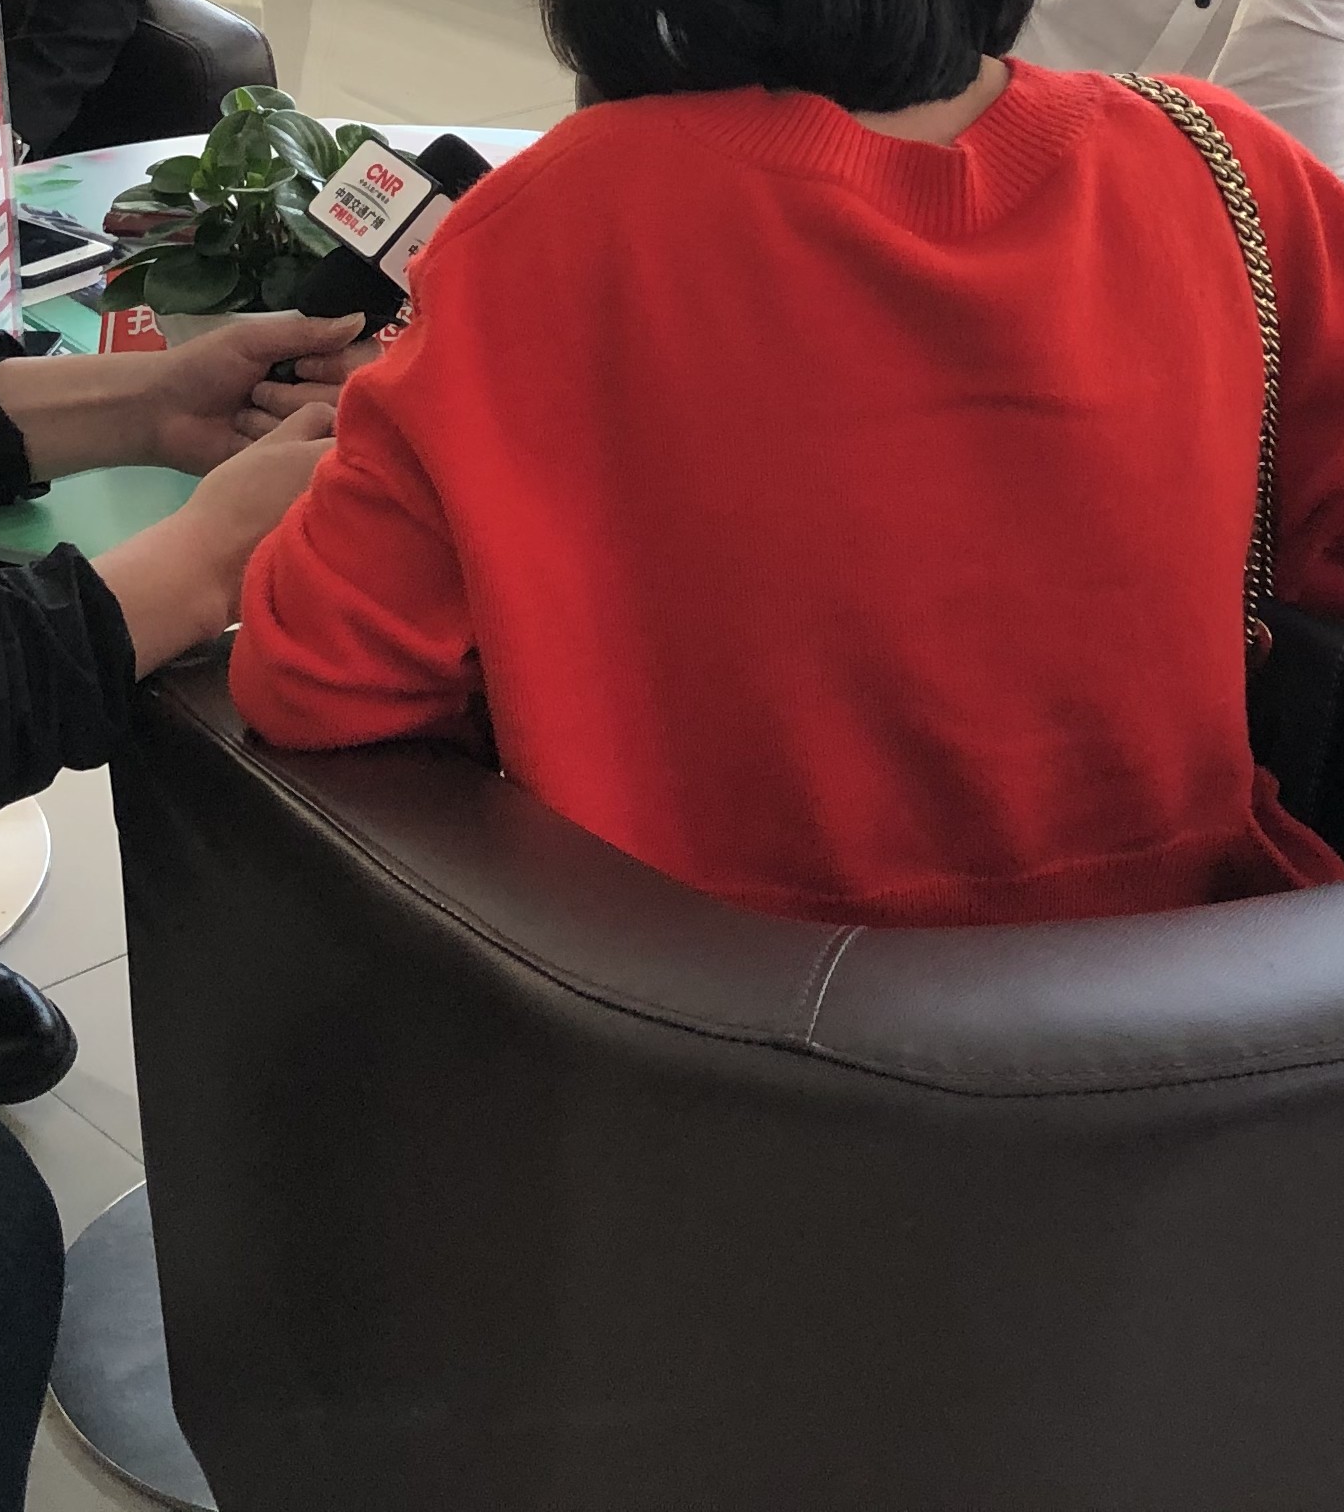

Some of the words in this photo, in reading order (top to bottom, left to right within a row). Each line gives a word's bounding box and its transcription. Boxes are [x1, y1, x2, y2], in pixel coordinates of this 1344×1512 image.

[366, 163, 404, 198] CNR
[328, 202, 369, 238] FM94.8
[334, 187, 386, 231] 中国交通广播
